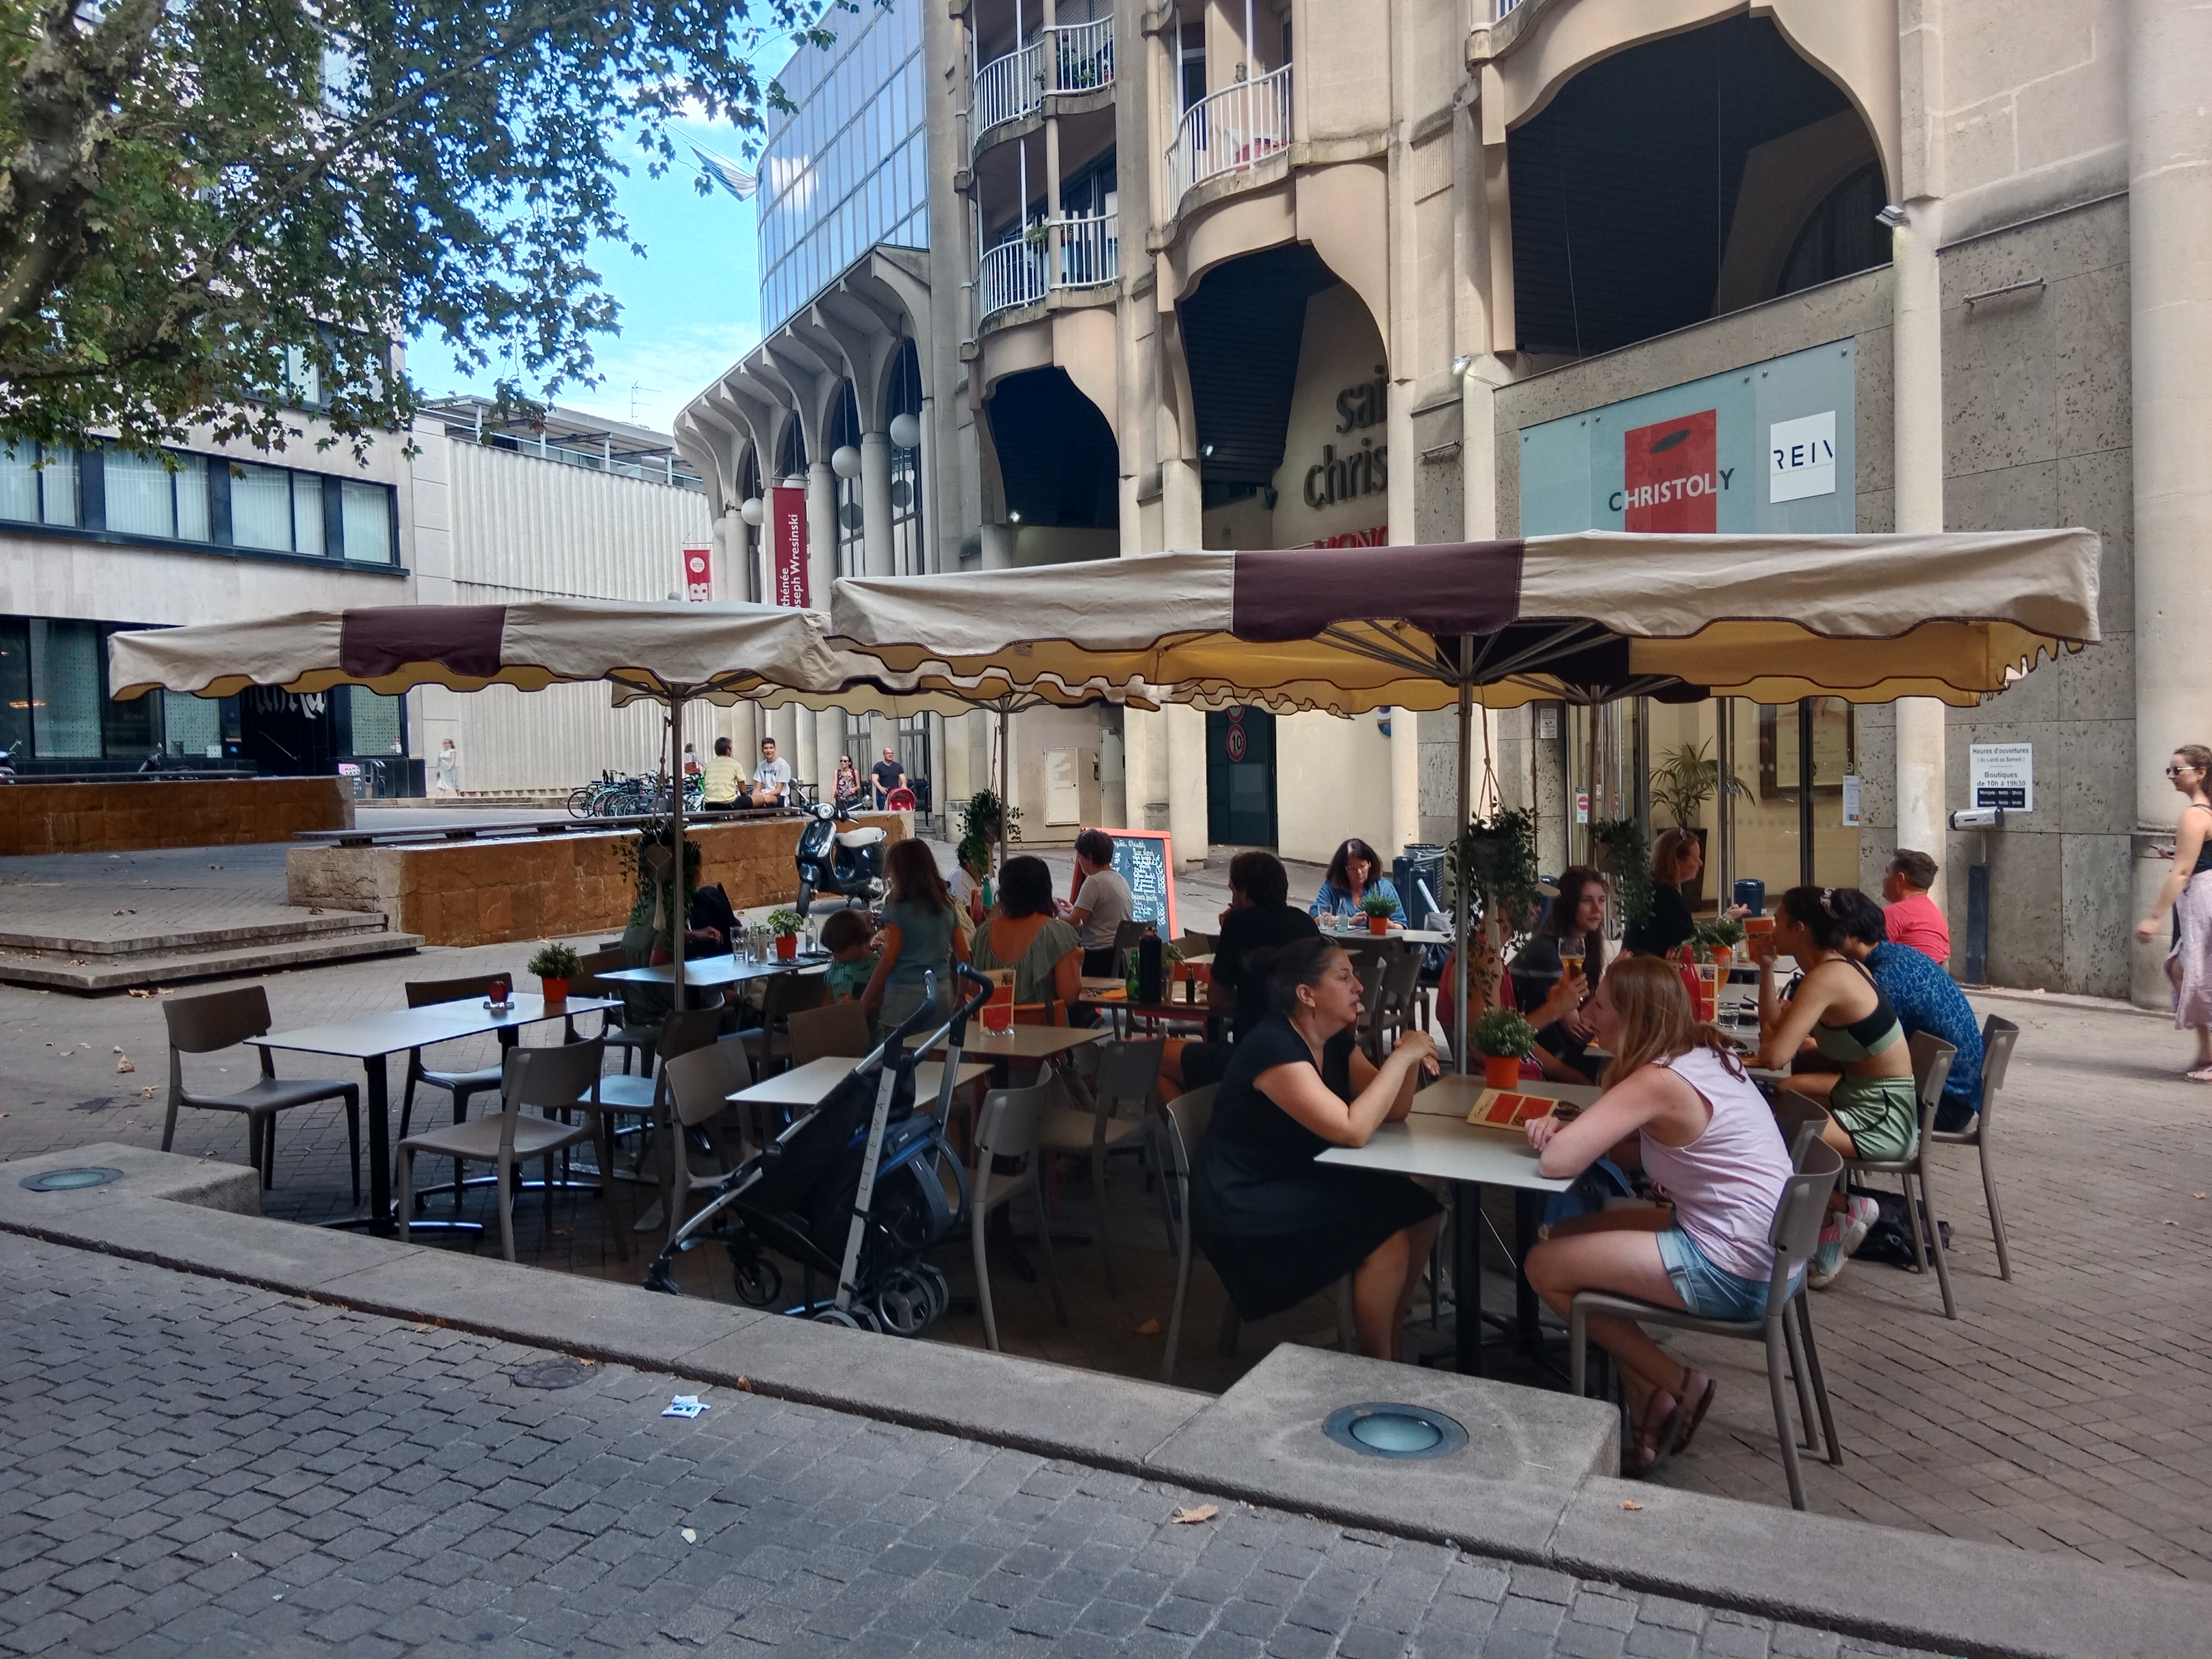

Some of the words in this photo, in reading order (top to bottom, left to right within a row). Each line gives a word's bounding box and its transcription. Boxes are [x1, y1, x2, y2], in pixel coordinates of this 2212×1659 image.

[1609, 468, 1735, 512] CHRISTOLY
[788, 514, 800, 575] Wresinski
[1232, 735, 1242, 750] 10
[1984, 771, 2018, 780] Boutiques
